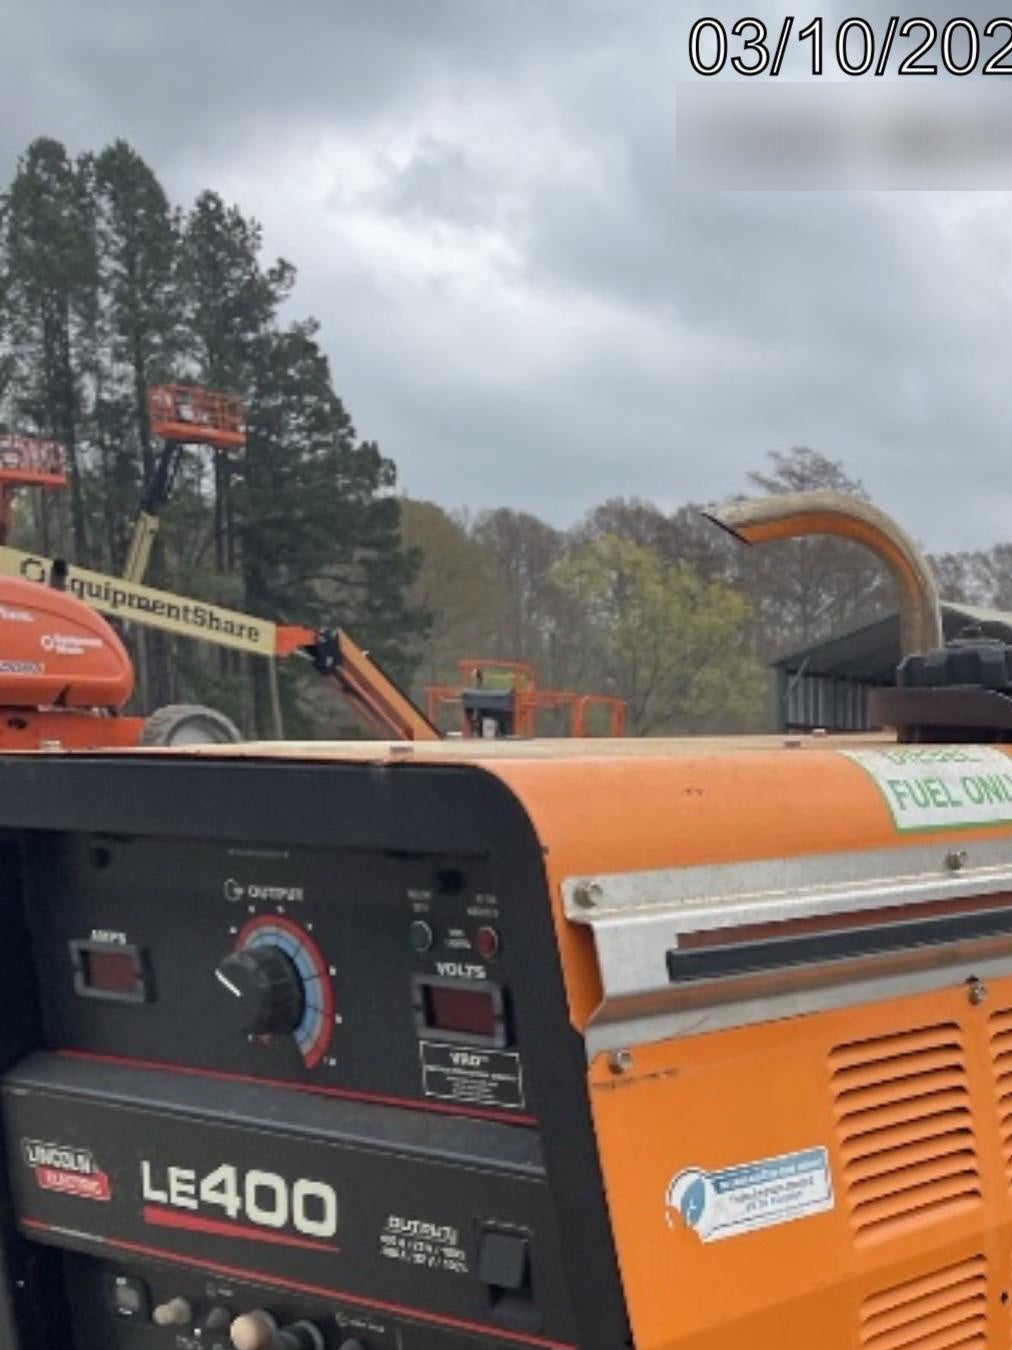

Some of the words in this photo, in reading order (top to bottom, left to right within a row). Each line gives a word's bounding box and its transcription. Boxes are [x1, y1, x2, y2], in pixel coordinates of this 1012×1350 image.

[66, 575, 260, 642] quipmentShare
[887, 777, 963, 810] FUEL
[436, 961, 487, 979] VOLTS
[28, 1144, 92, 1174] LINCOLN
[45, 1173, 102, 1197] ELECTRIC
[140, 1160, 338, 1238] LE400
